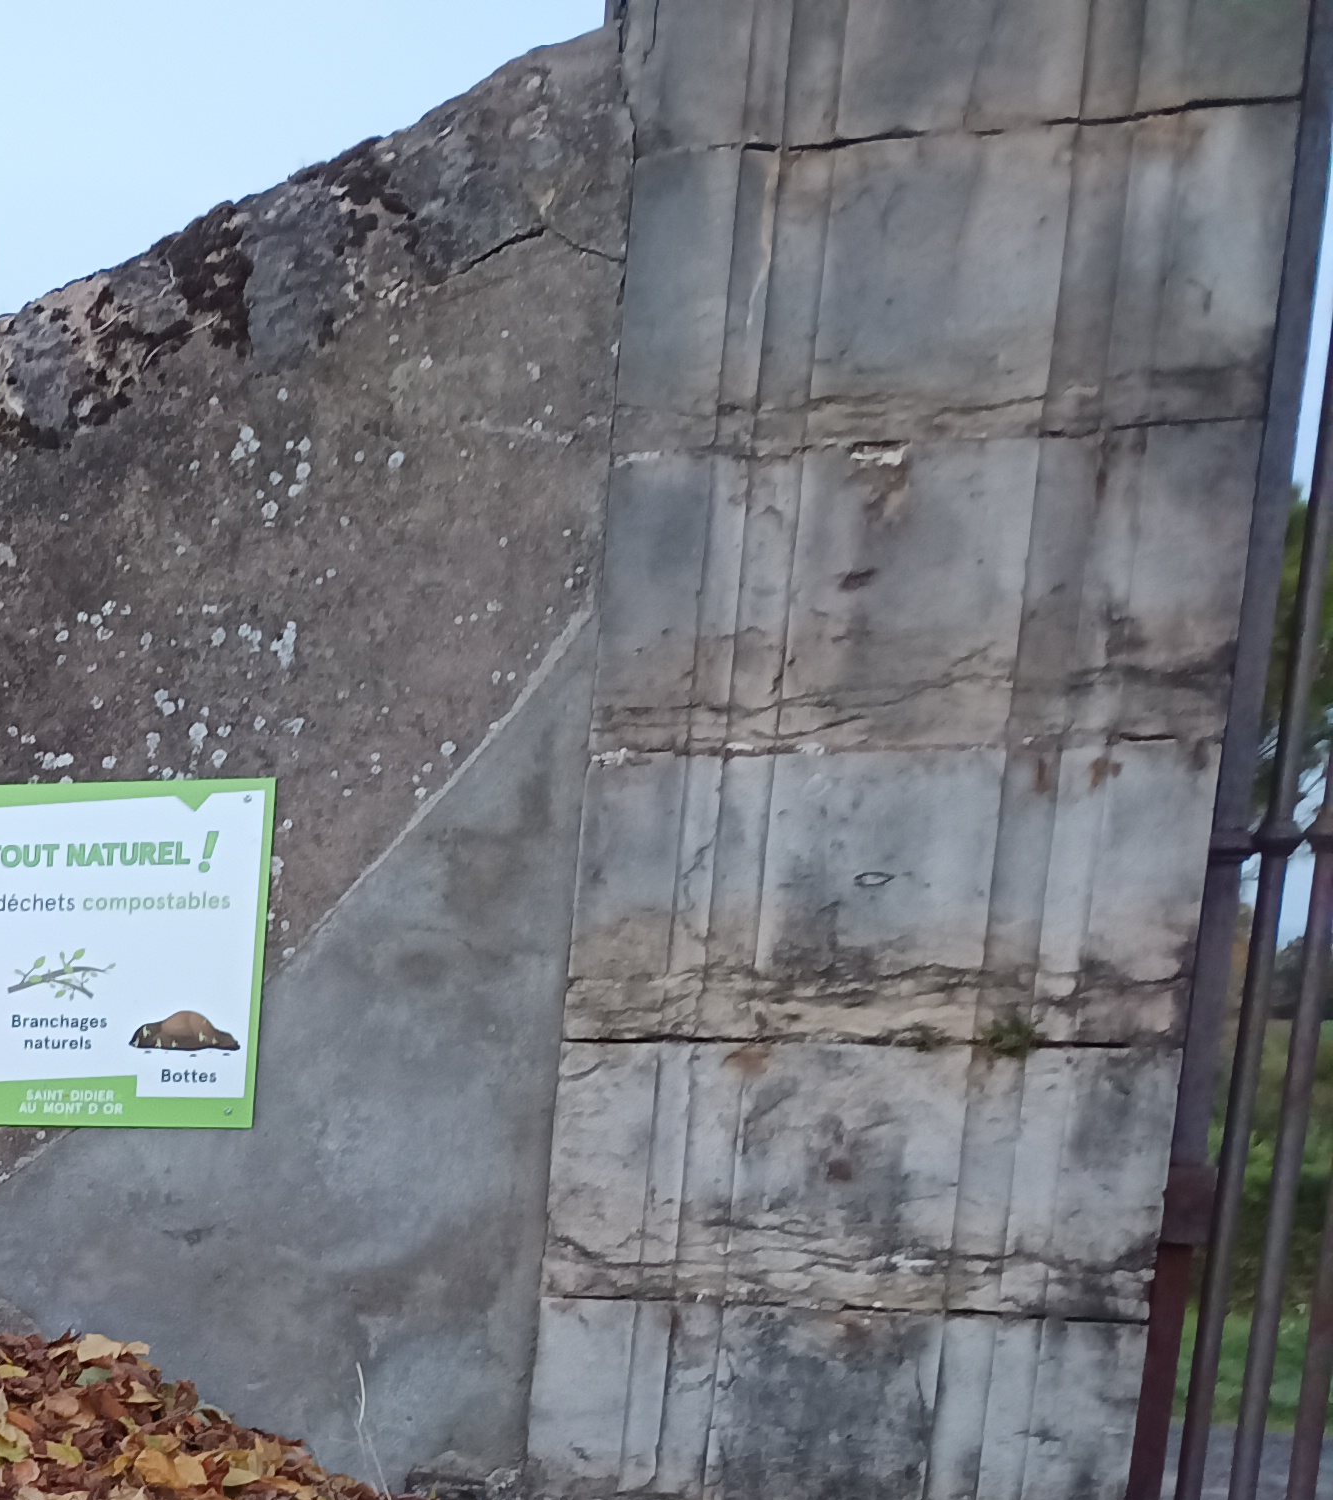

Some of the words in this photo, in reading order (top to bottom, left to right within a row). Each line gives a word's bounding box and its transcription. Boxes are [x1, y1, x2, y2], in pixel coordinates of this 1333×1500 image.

[66, 841, 191, 867] NATUREL
[81, 890, 231, 916] compostables
[11, 1014, 108, 1031] Branchages
[23, 1036, 92, 1050] naturels
[160, 1068, 217, 1083] Bottes
